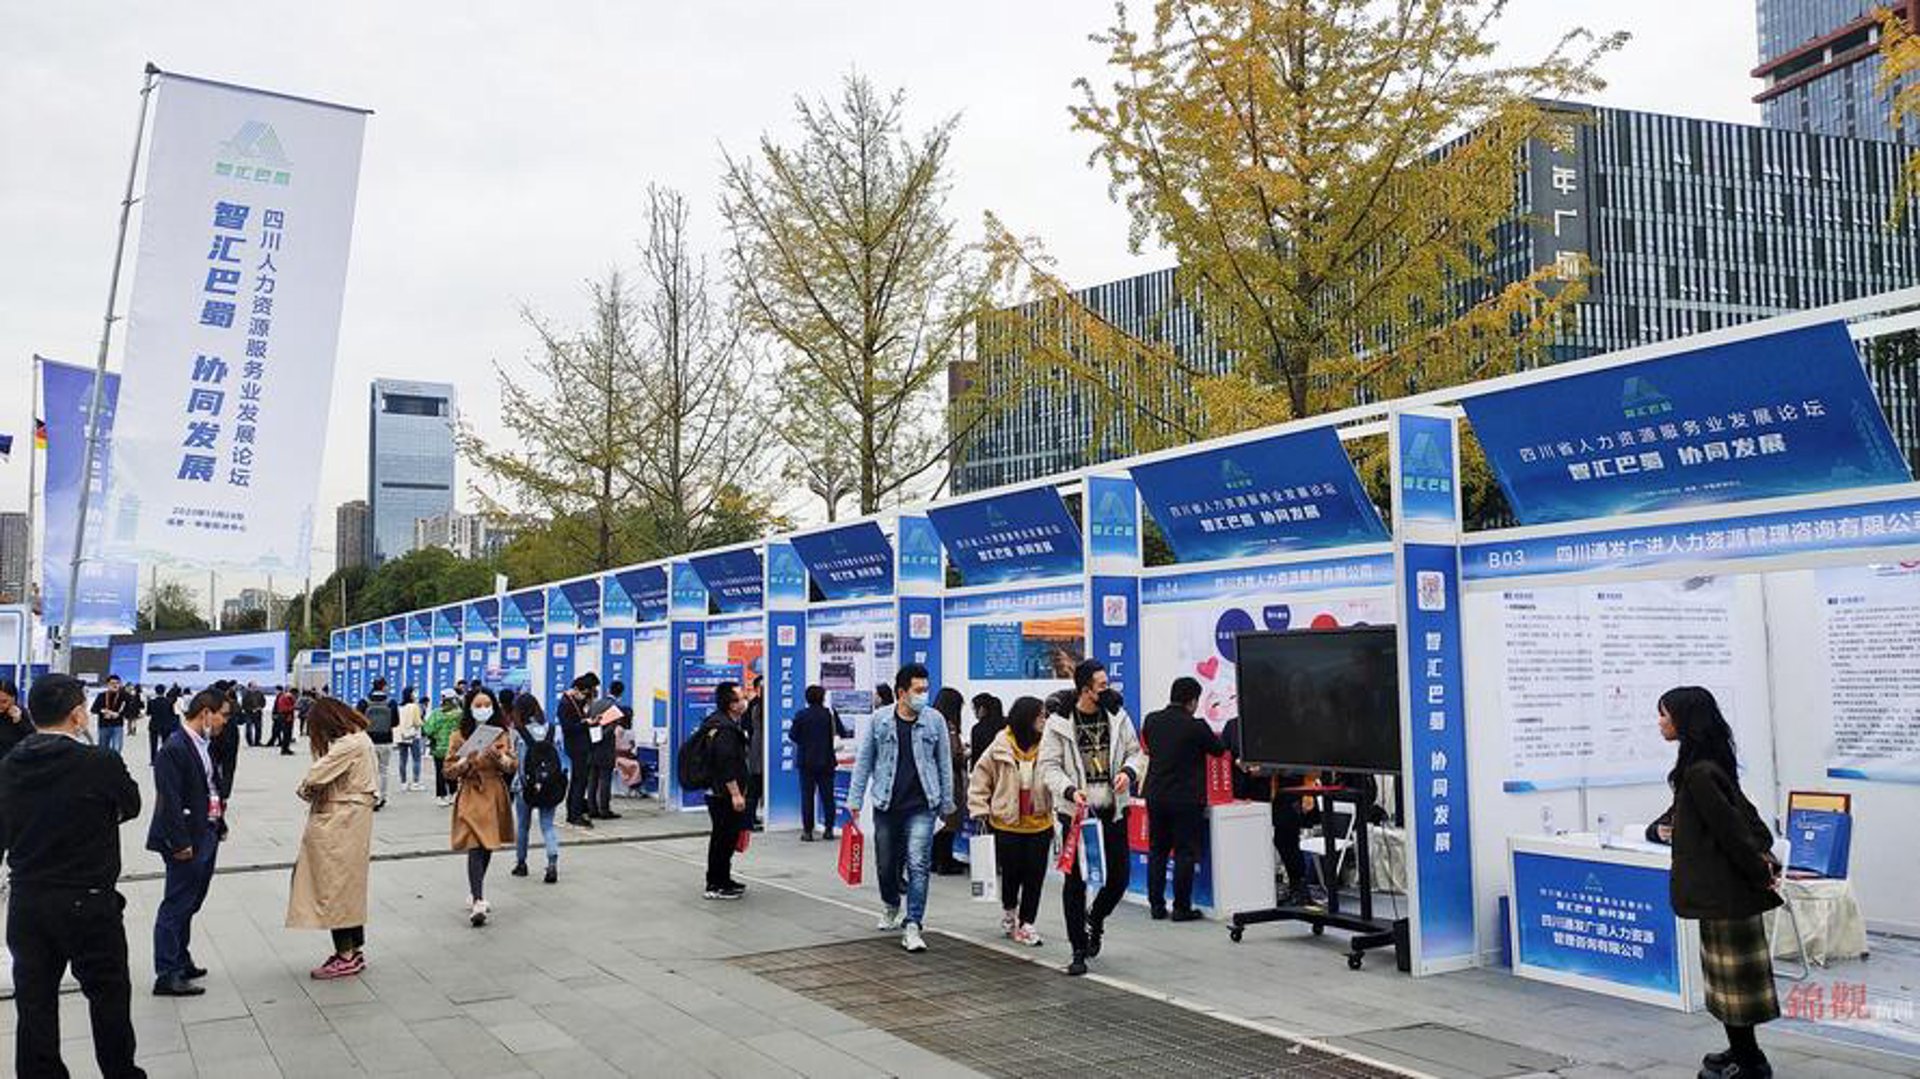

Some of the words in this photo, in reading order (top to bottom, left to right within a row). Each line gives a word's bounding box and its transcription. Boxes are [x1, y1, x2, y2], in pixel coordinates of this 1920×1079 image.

[199, 201, 250, 329] 智汇巴蜀
[228, 209, 284, 488] 四川人力资源服务业发展论坛
[177, 355, 229, 482] 协同发展
[1520, 399, 1826, 462] 四川省人力资源服务业发展论坛
[1567, 449, 1664, 480] 智汇巴蜀
[1677, 432, 1787, 466] 协同发展
[1488, 549, 1525, 569] B03
[1426, 632, 1445, 731] 智汇巴蜀
[1431, 751, 1451, 853] 协同发展
